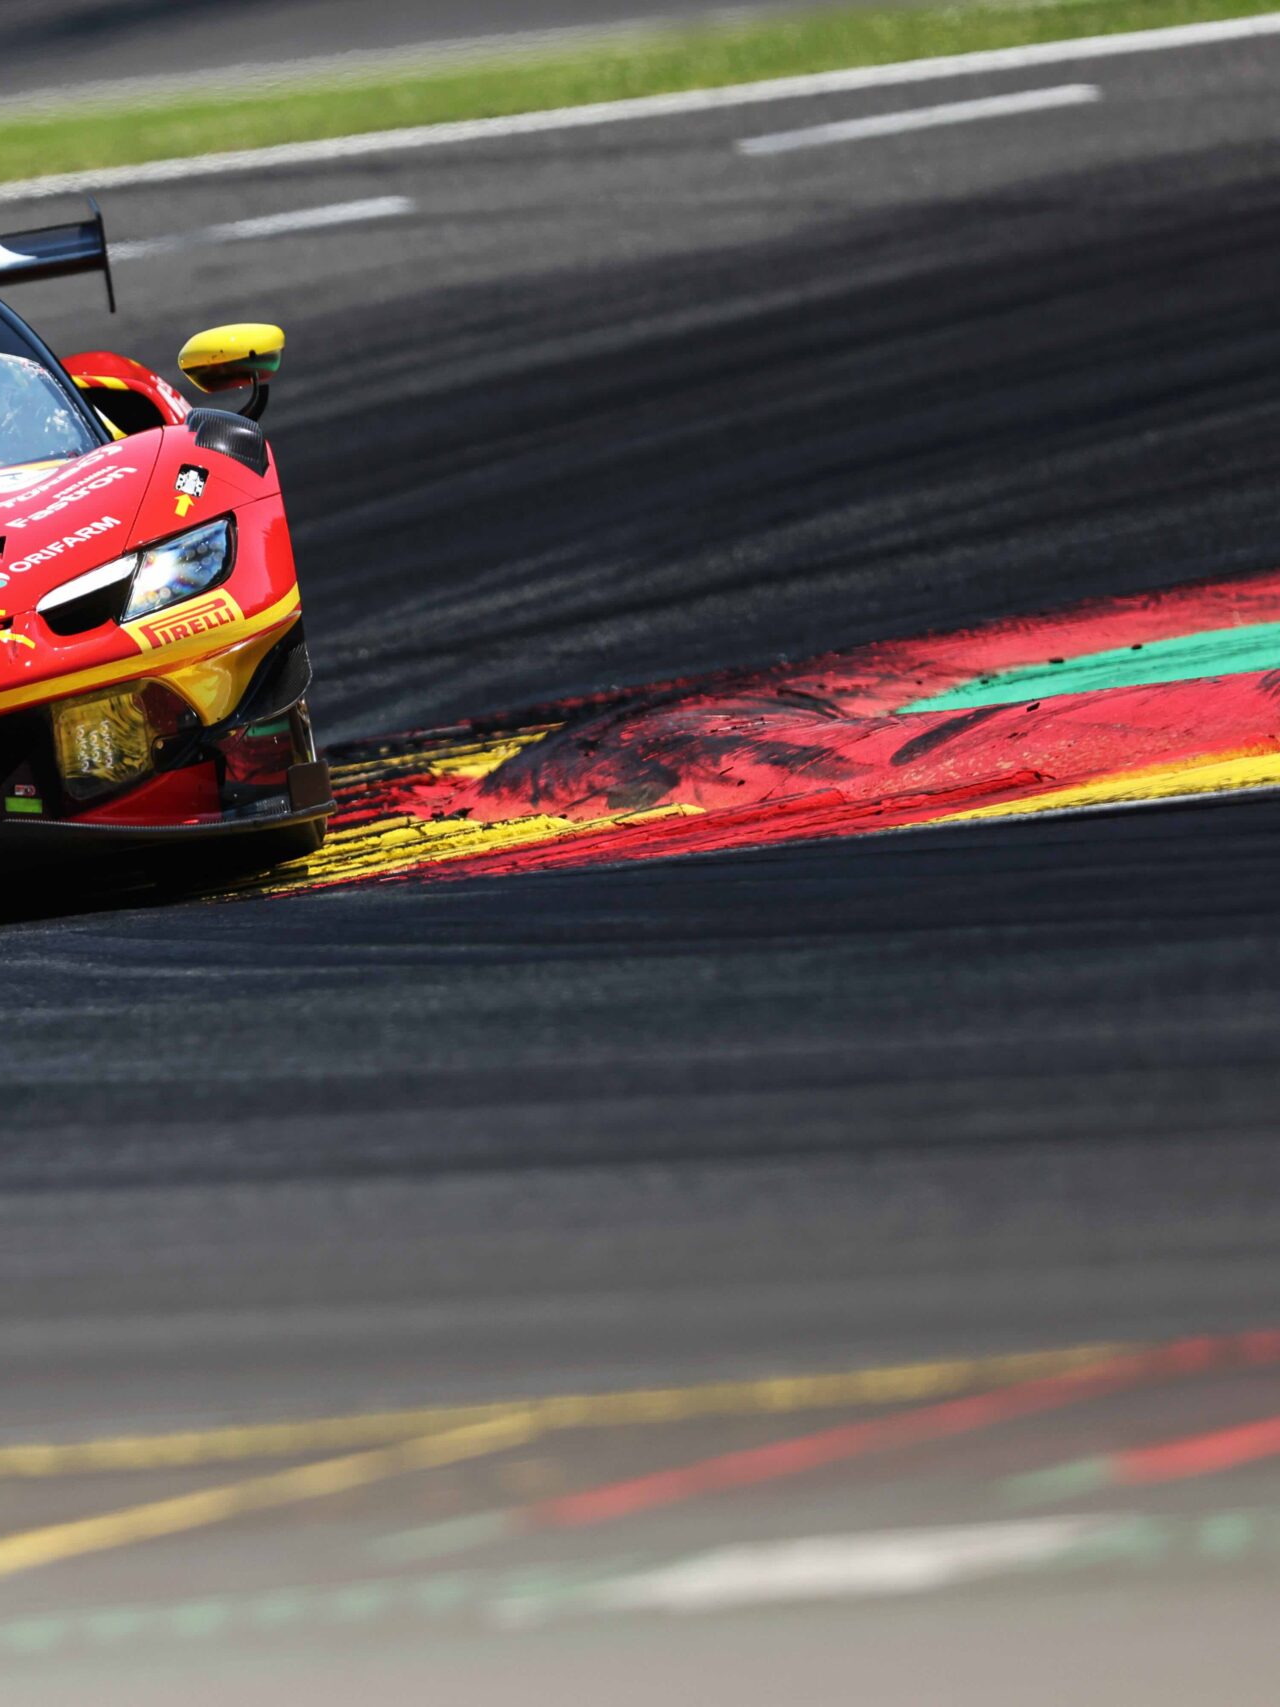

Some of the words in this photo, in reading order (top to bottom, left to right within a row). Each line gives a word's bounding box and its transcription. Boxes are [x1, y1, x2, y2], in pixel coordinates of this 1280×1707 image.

[5, 465, 137, 529] Fastron
[8, 515, 122, 573] ORIFARM
[138, 597, 237, 650] PIRELLI
